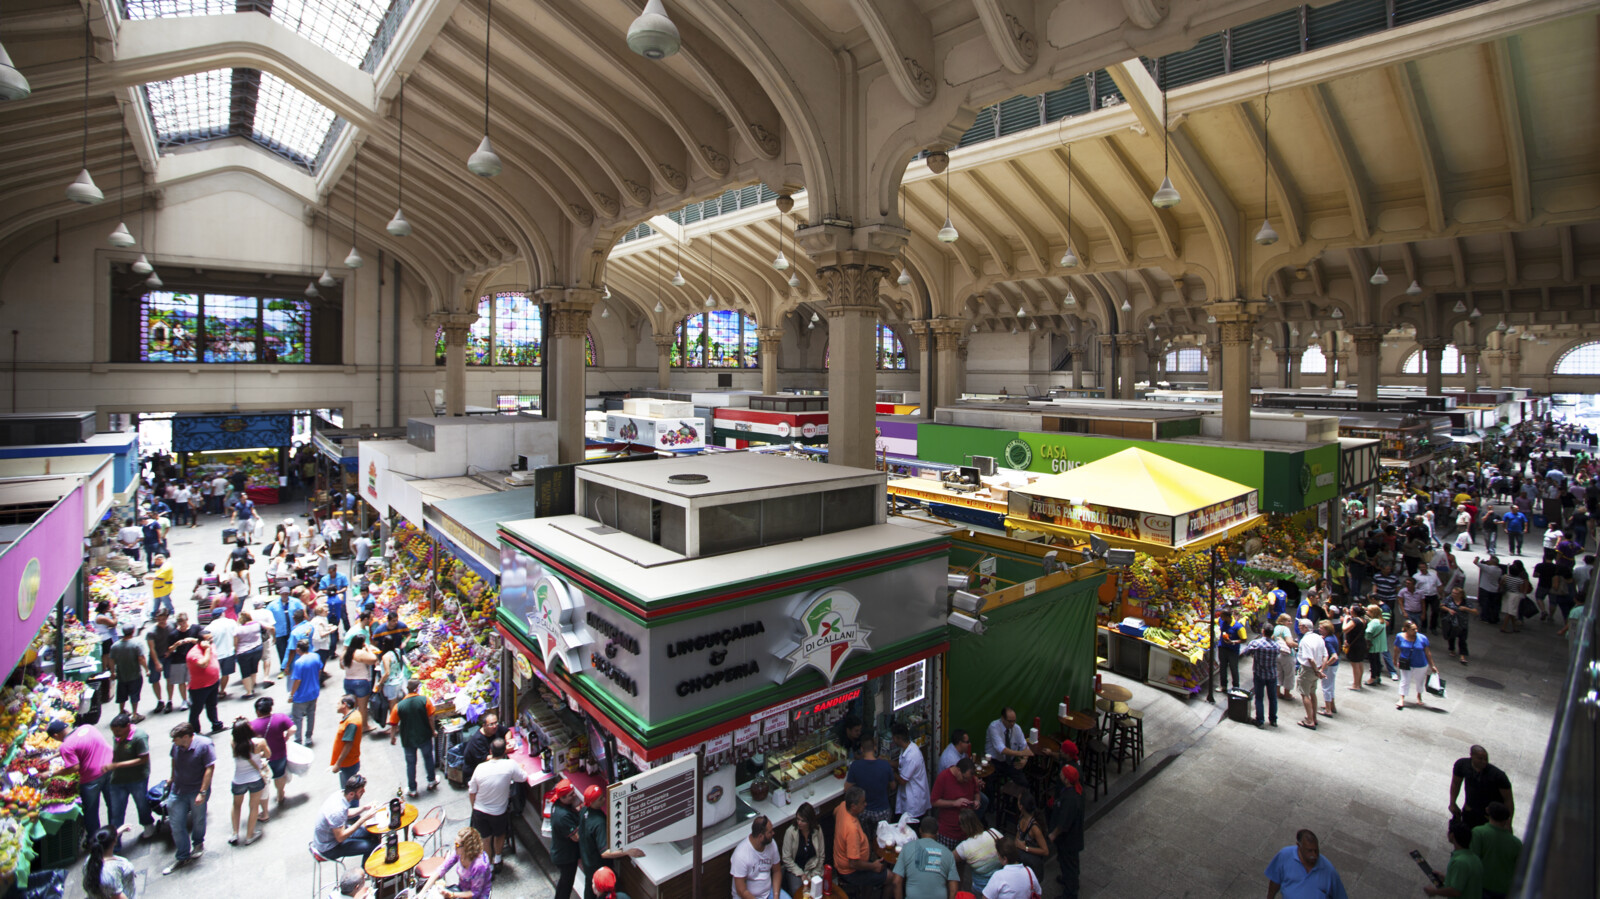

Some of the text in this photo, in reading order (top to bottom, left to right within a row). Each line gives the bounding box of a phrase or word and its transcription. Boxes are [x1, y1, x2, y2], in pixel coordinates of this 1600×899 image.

[1040, 444, 1068, 460] CASA
[1032, 501, 1137, 530] FRUTAS PARPINELLI LTDA.
[1189, 512, 1209, 531] FRUTAS
[666, 620, 765, 658] LINGUIÇARIA
[805, 630, 855, 652] DI CALLANI
[605, 642, 618, 660] &
[708, 649, 728, 666] &
[675, 659, 760, 697] CHOPERIA
[761, 701, 798, 716] Fabricação
[798, 692, 822, 704] Própria
[813, 689, 861, 714] SANDUICH
[612, 781, 638, 799] Rua K
[629, 793, 645, 802] Frutas
[629, 804, 640, 812] Rua
[646, 793, 669, 805] Cantareira
[629, 813, 640, 821] Rua
[646, 807, 653, 815] de
[652, 802, 667, 812] Março
[630, 832, 645, 841] Sucos
